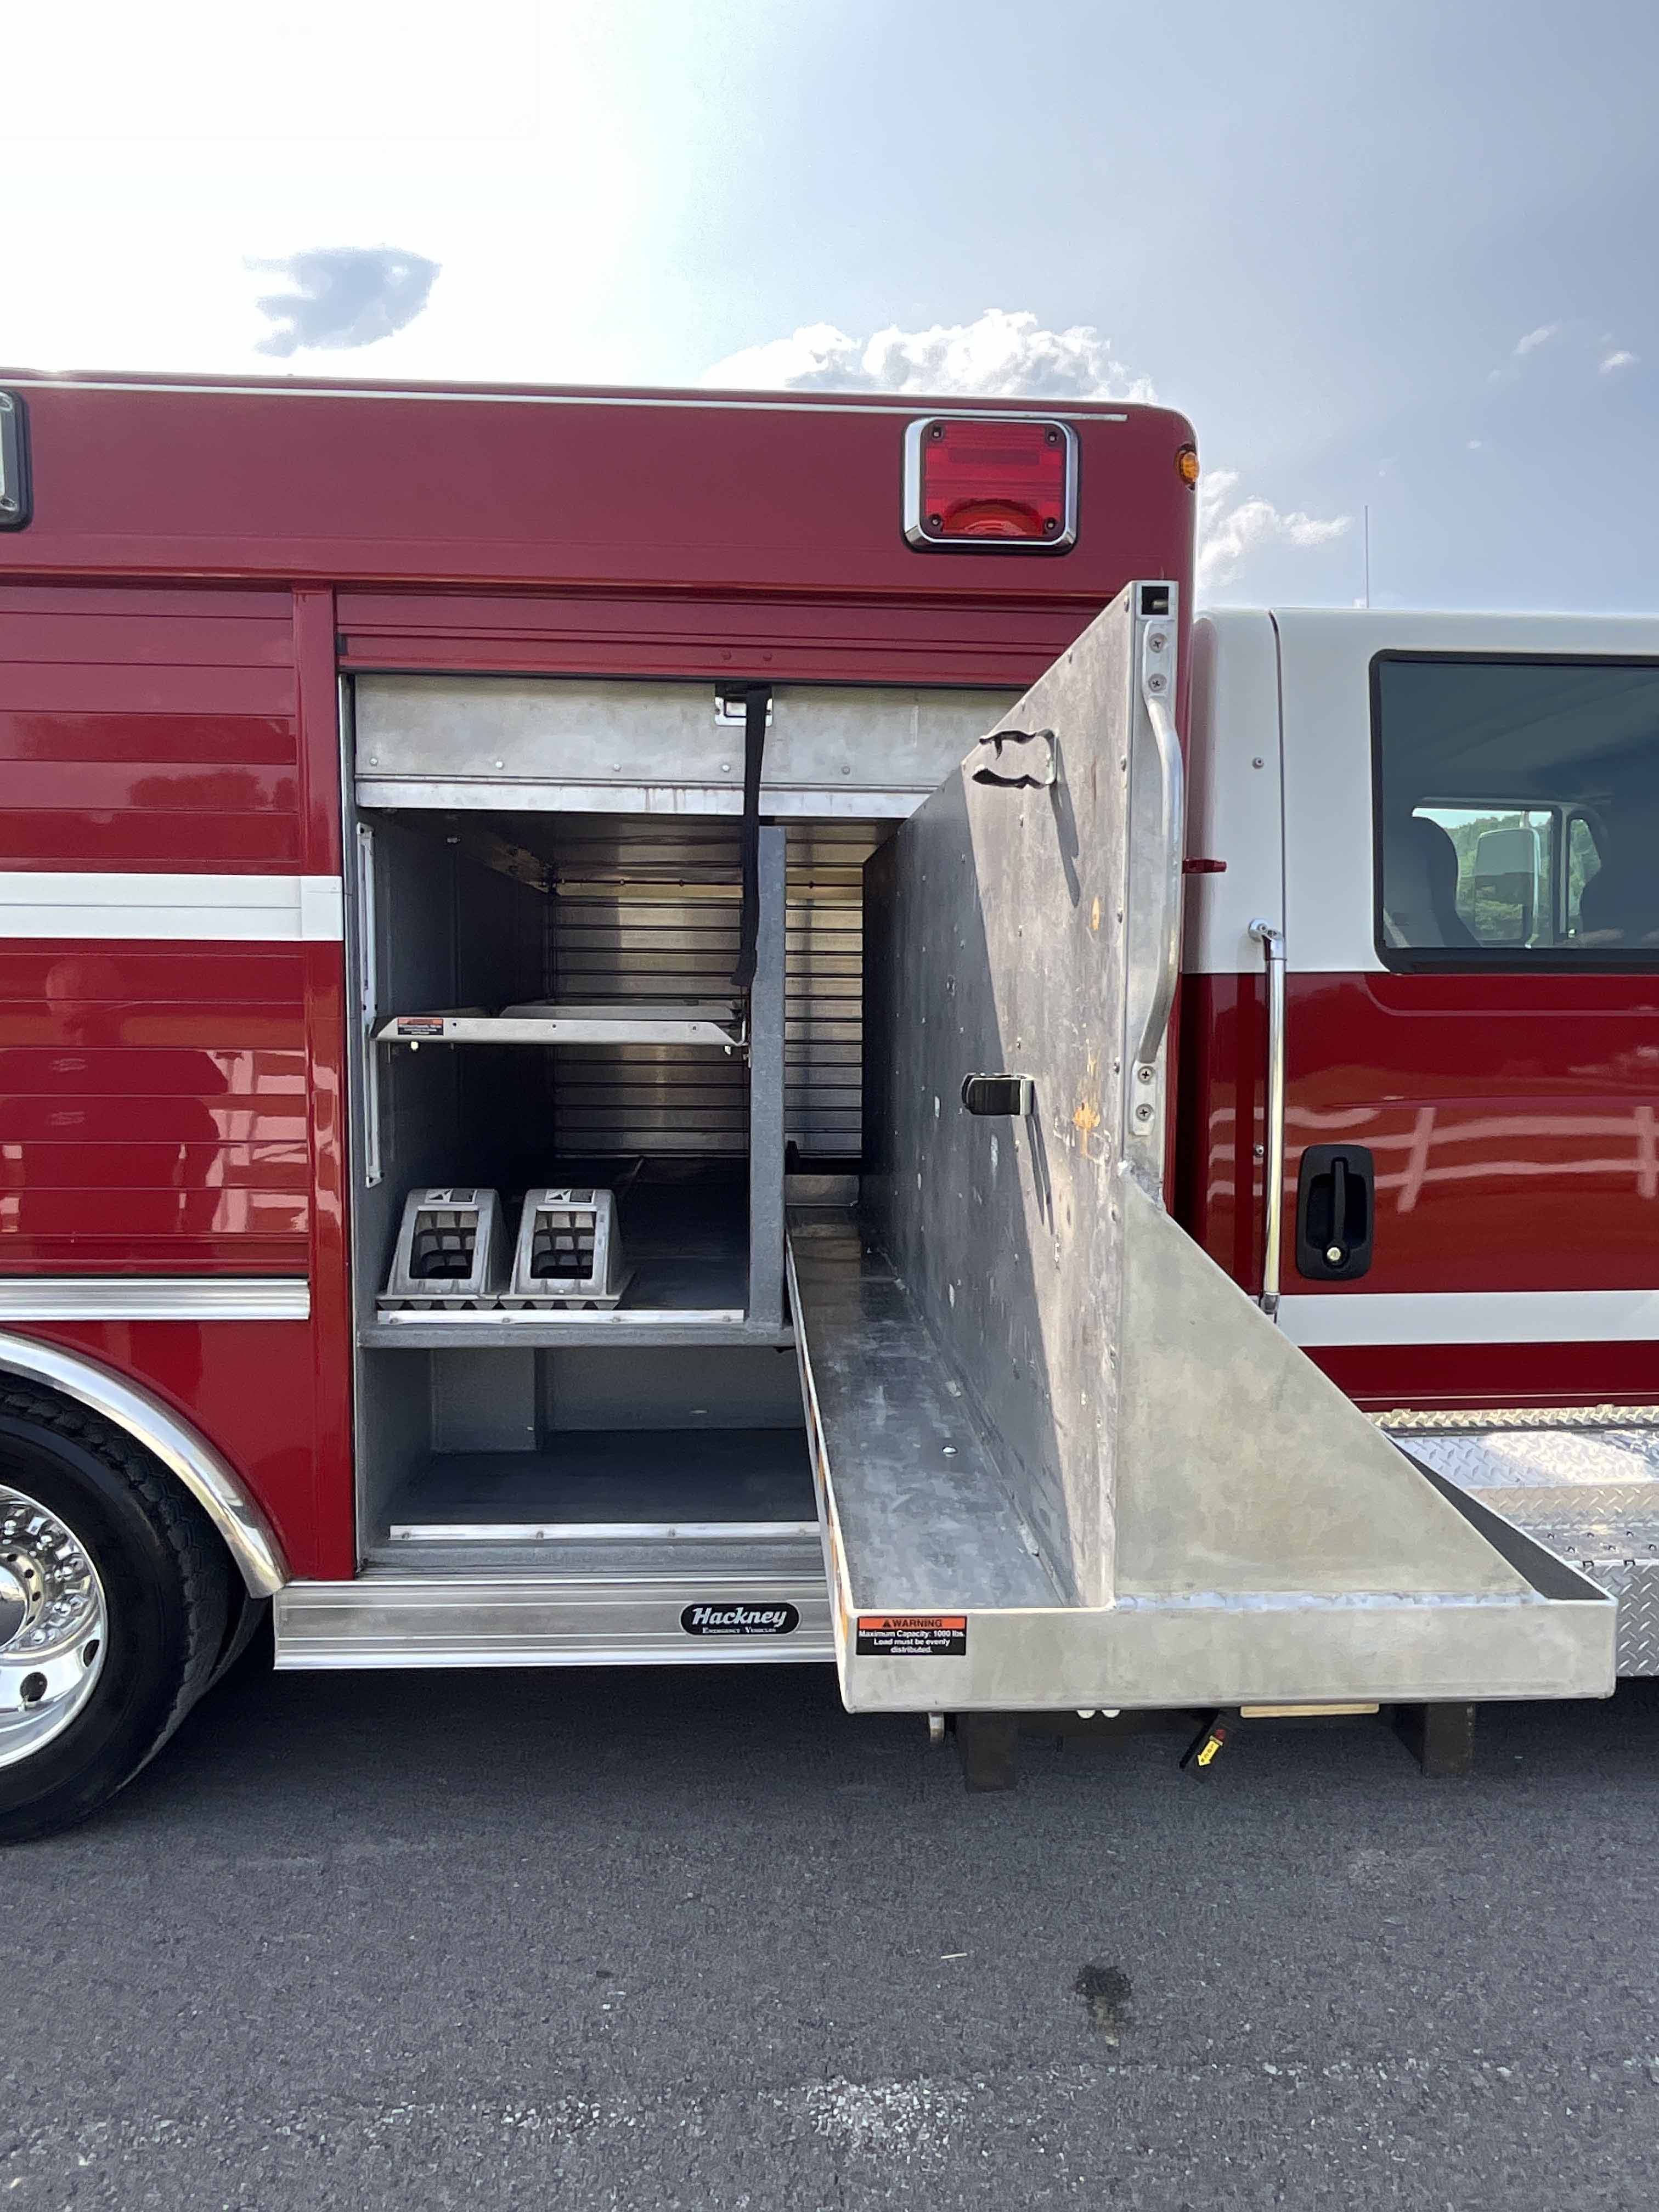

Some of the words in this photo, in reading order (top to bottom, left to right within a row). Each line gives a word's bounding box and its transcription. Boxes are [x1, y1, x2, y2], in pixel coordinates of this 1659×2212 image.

[692, 1606, 787, 1628] Hackney
[892, 1619, 943, 1627] WARNING
[896, 1630, 932, 1639] Capacity:
[926, 1638, 950, 1646] evenly
